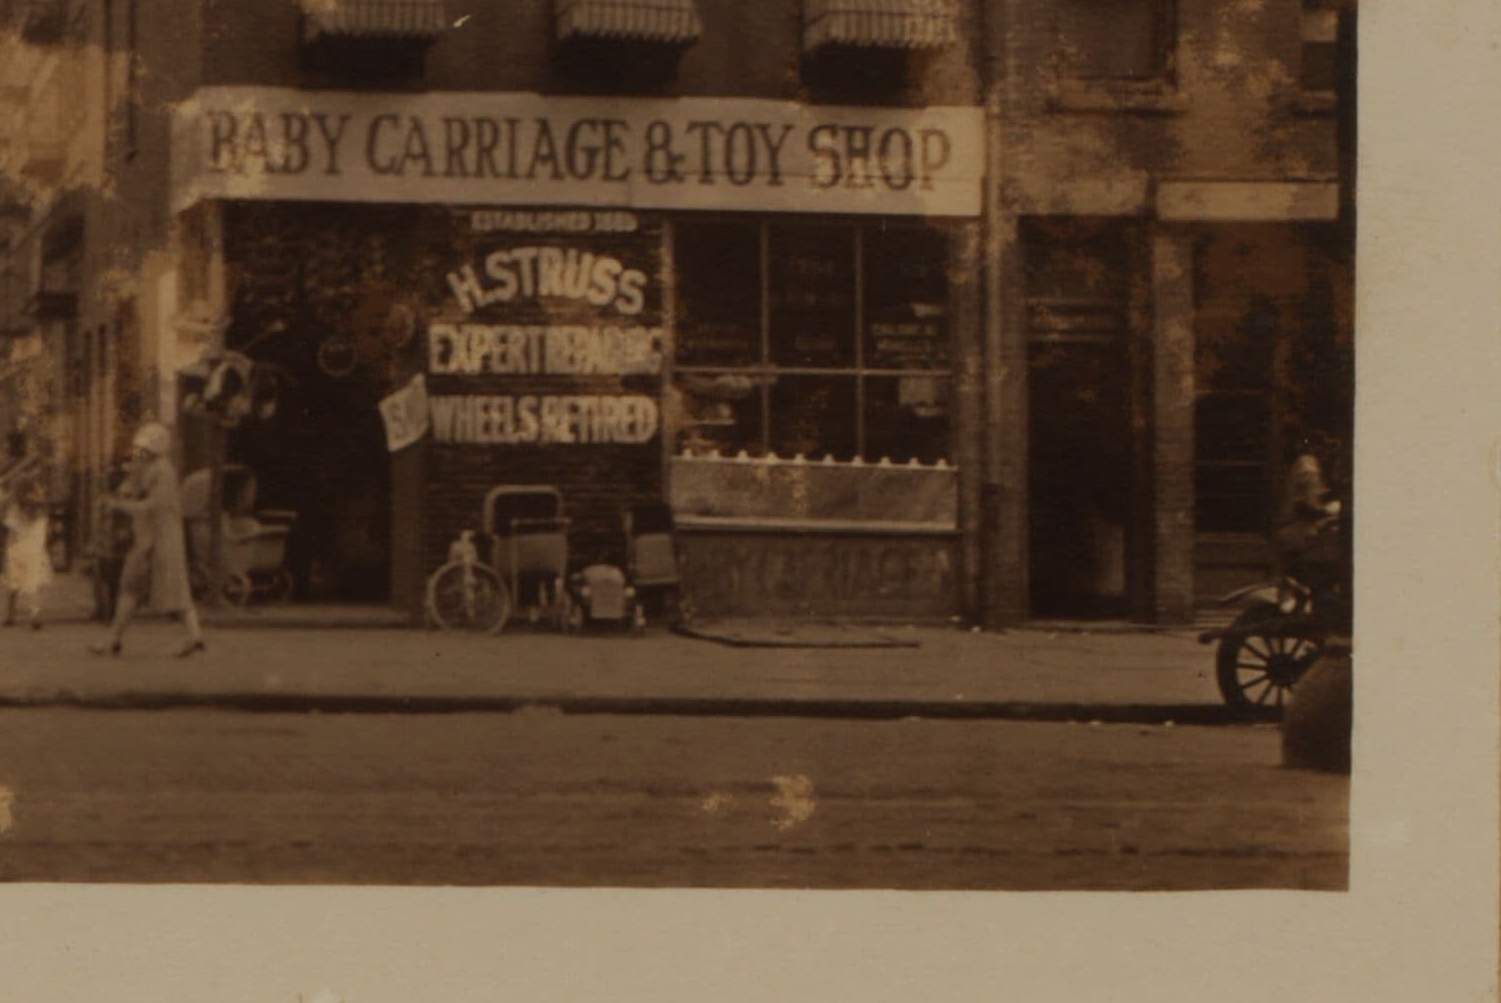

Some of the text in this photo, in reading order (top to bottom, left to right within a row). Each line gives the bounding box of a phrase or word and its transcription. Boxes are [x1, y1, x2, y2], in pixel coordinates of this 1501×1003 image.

[208, 108, 952, 191] BABY CARRIAGE & TOY SHOP
[485, 246, 648, 315] STRUSS
[428, 324, 543, 375] EXPERT
[427, 395, 539, 444] WHEELS
[540, 395, 660, 445] RETIRED
